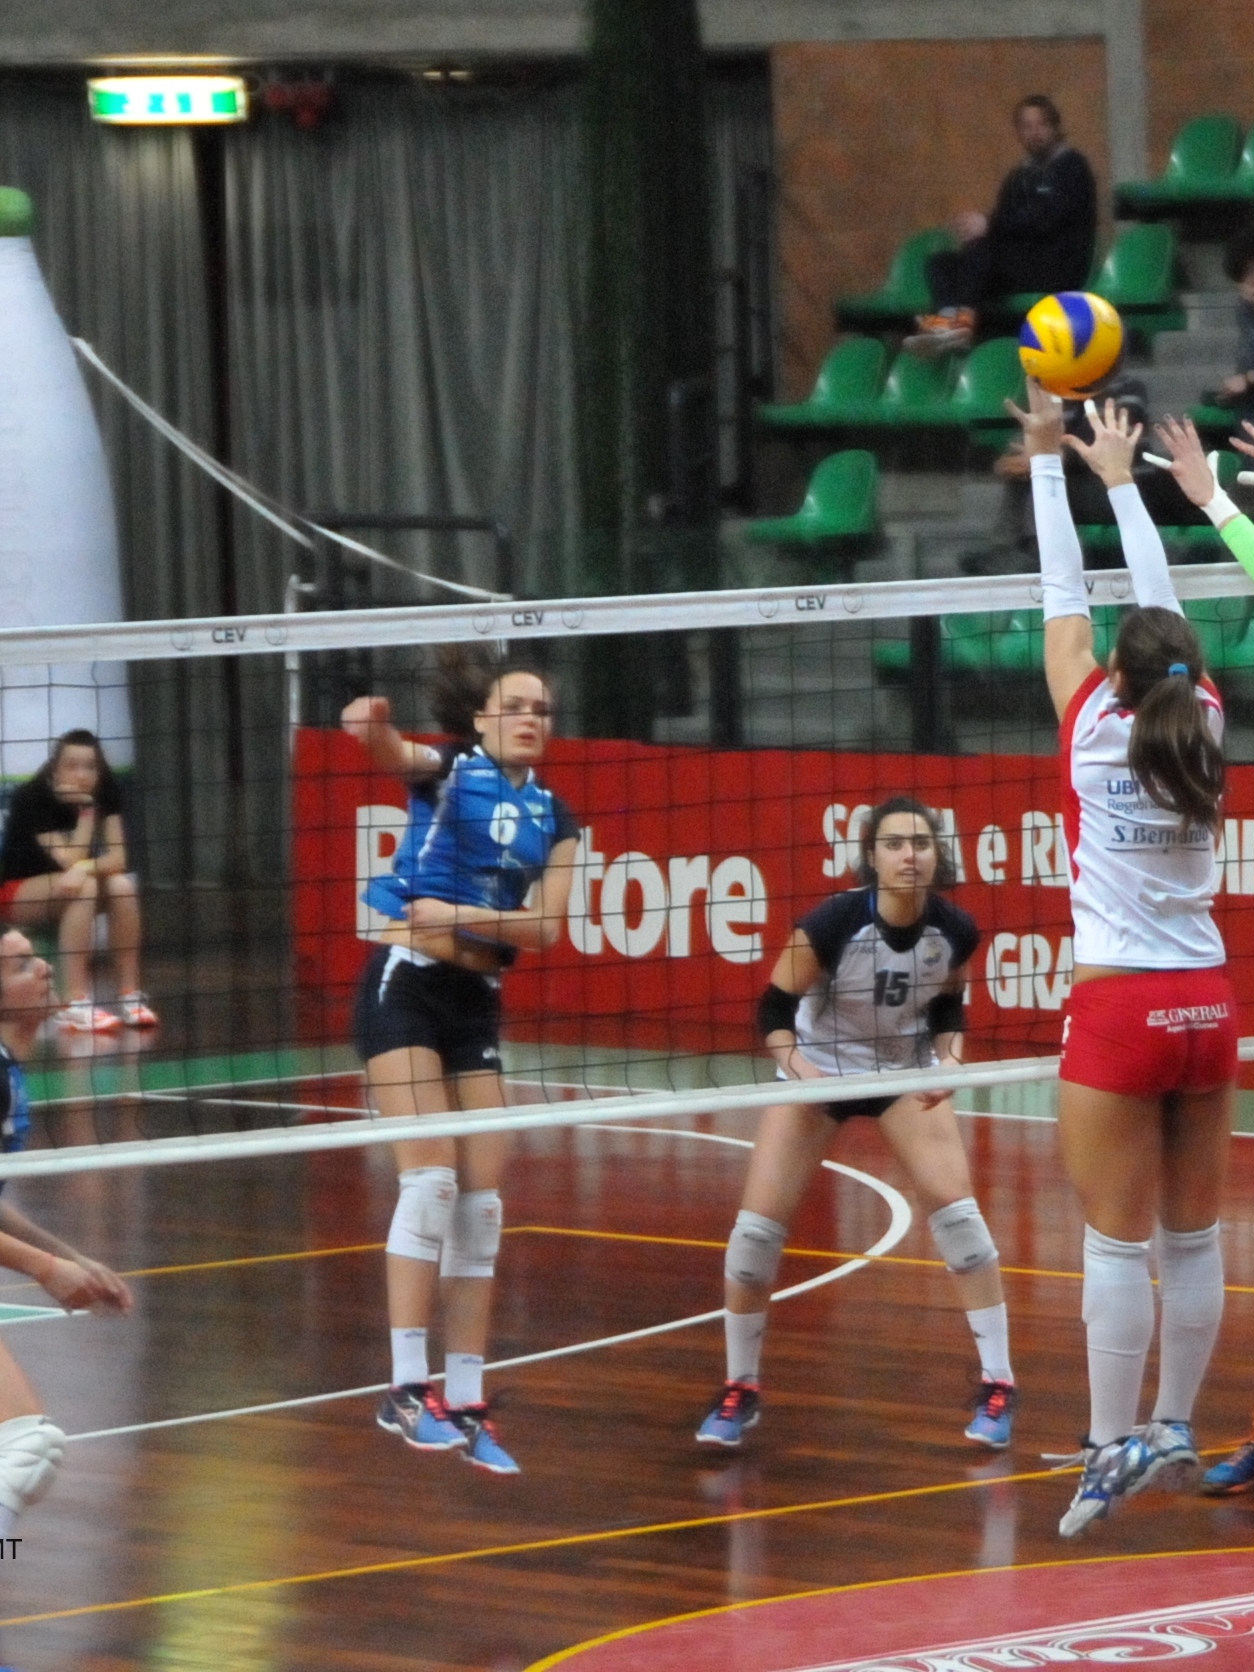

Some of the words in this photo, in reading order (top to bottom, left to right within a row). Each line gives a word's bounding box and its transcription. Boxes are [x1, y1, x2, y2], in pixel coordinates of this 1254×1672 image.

[794, 594, 828, 612] CEV
[511, 610, 545, 628] CEV
[211, 627, 247, 645] CEV
[488, 801, 520, 845] 6
[977, 824, 1008, 885] e
[873, 969, 910, 1008] 15
[1168, 1003, 1229, 1023] GENERALI
